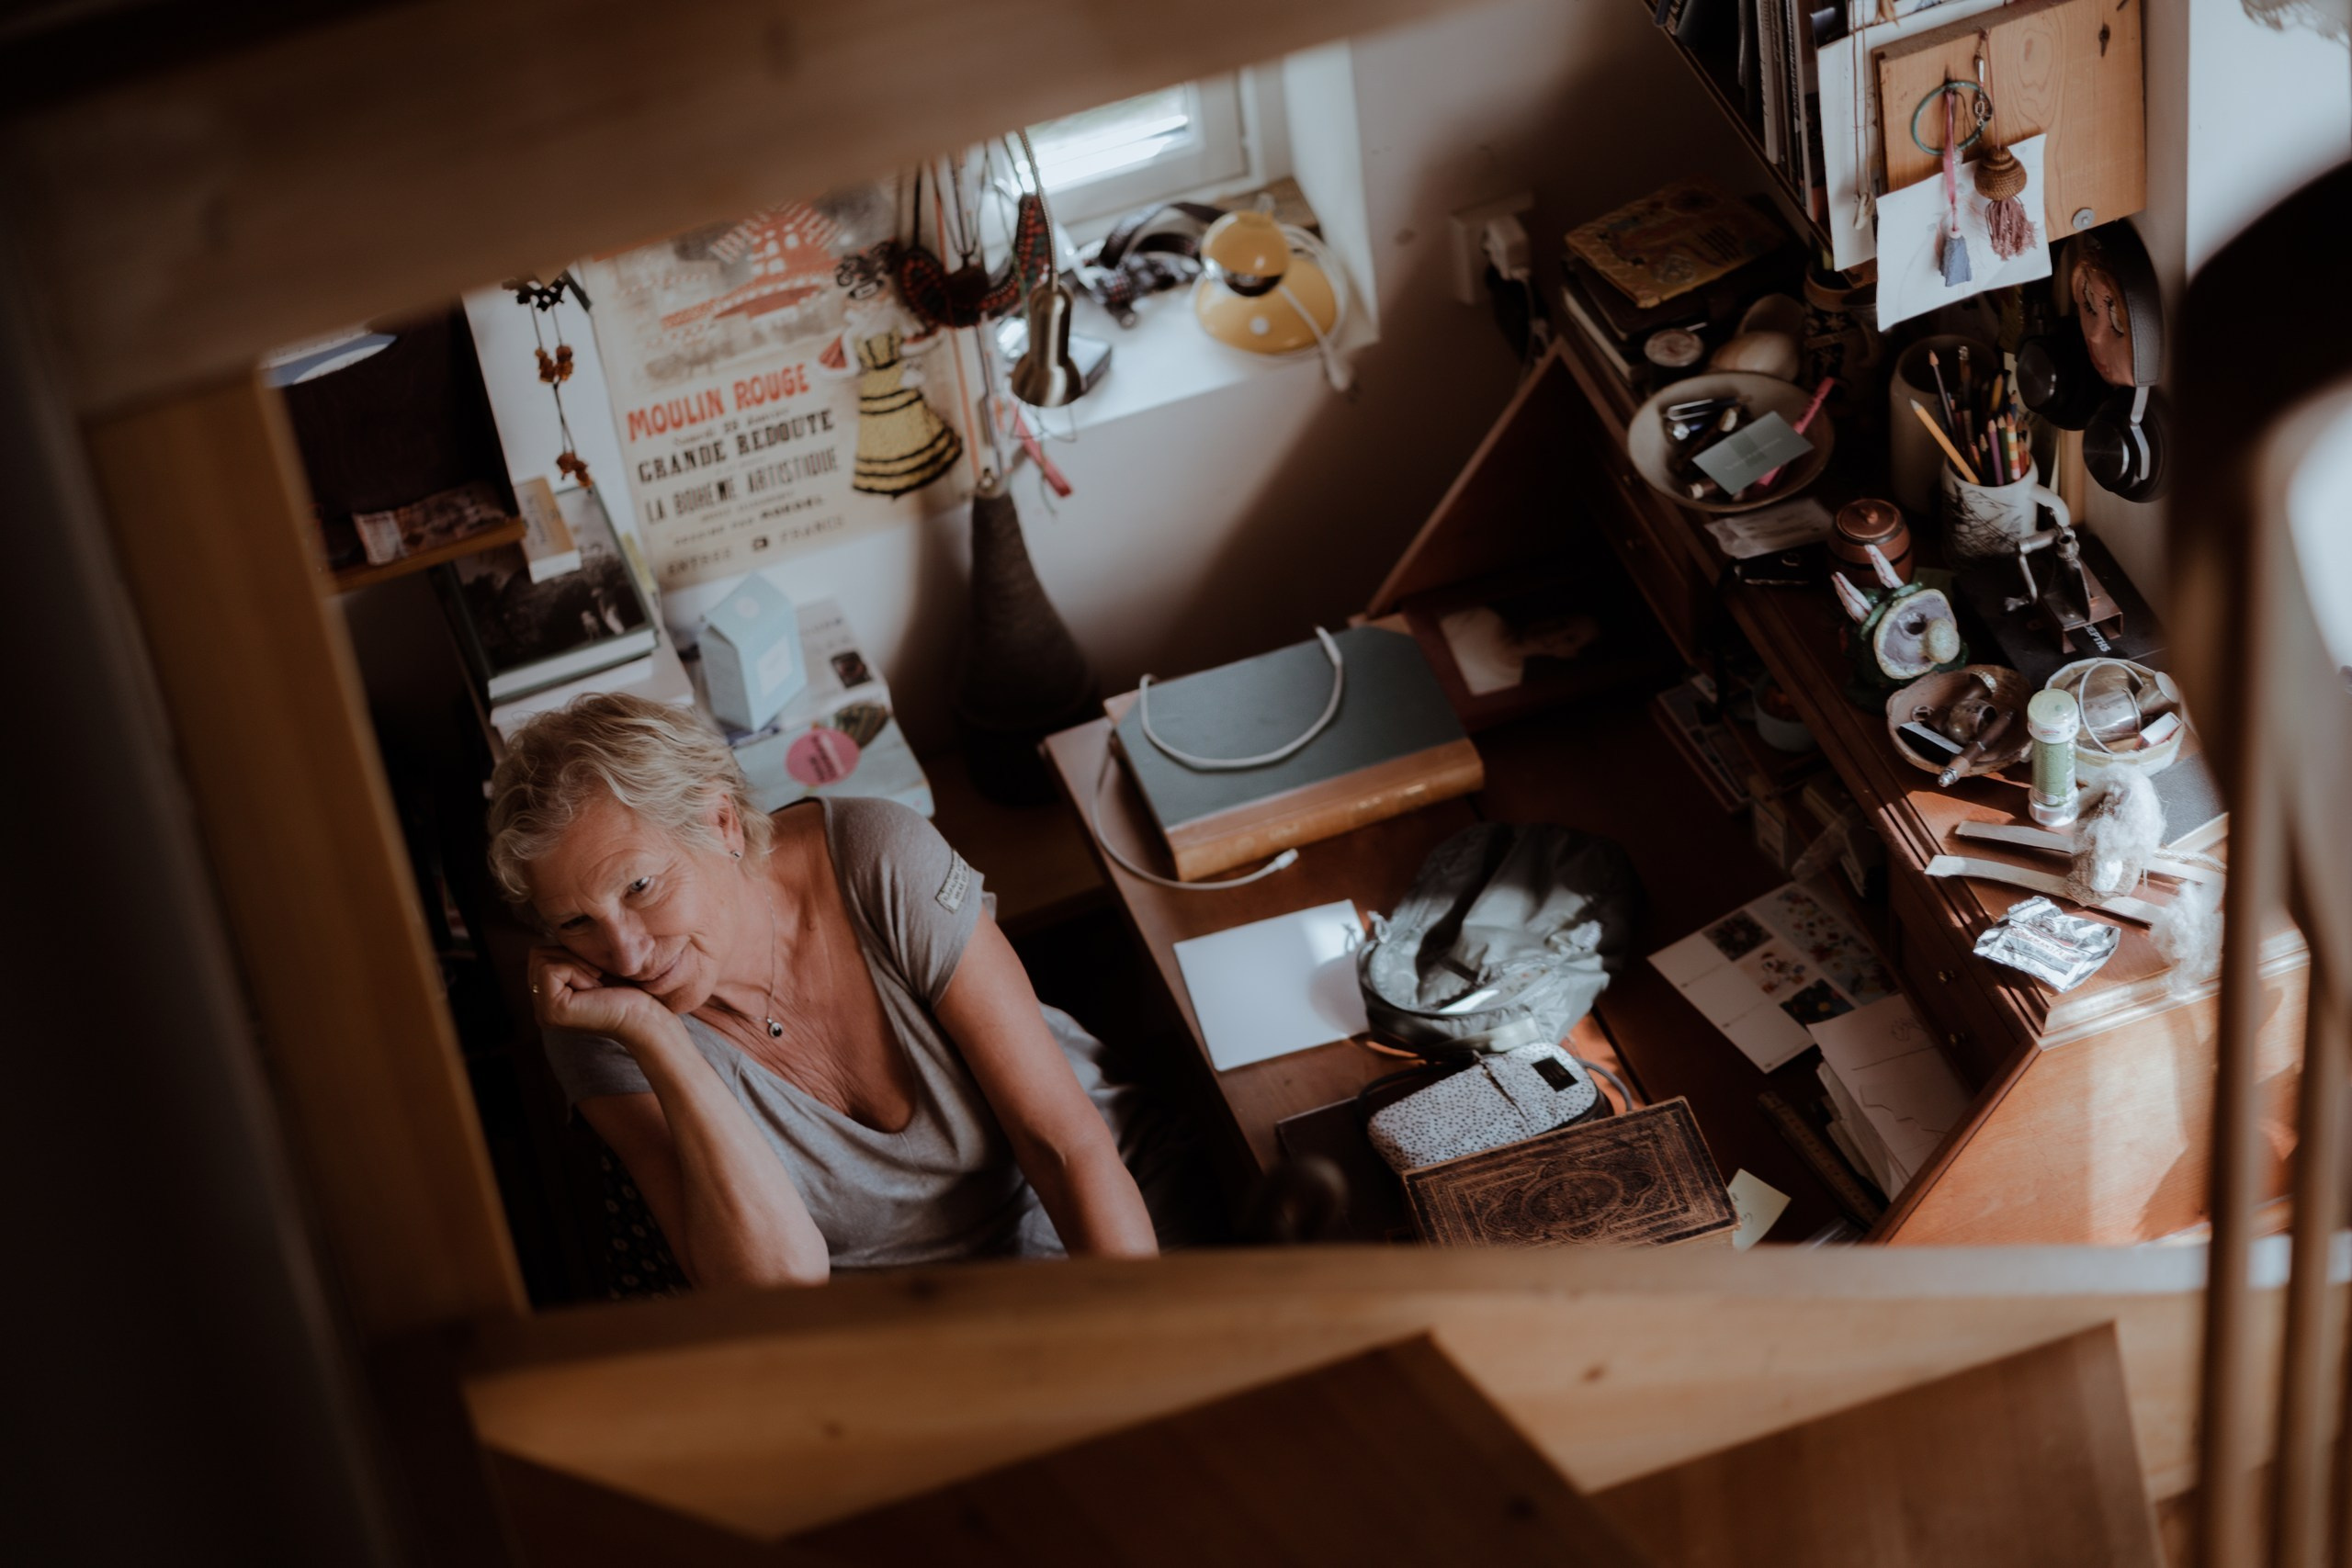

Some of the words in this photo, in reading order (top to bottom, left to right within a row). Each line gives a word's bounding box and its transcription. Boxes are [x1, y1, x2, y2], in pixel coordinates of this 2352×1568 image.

[628, 387, 725, 444] MOULIN
[733, 365, 808, 411] ROUGE
[638, 441, 727, 483] GRANDE
[736, 409, 833, 456] REDOUTE
[645, 500, 666, 524] LA
[748, 447, 838, 492] ARTISTIQUE
